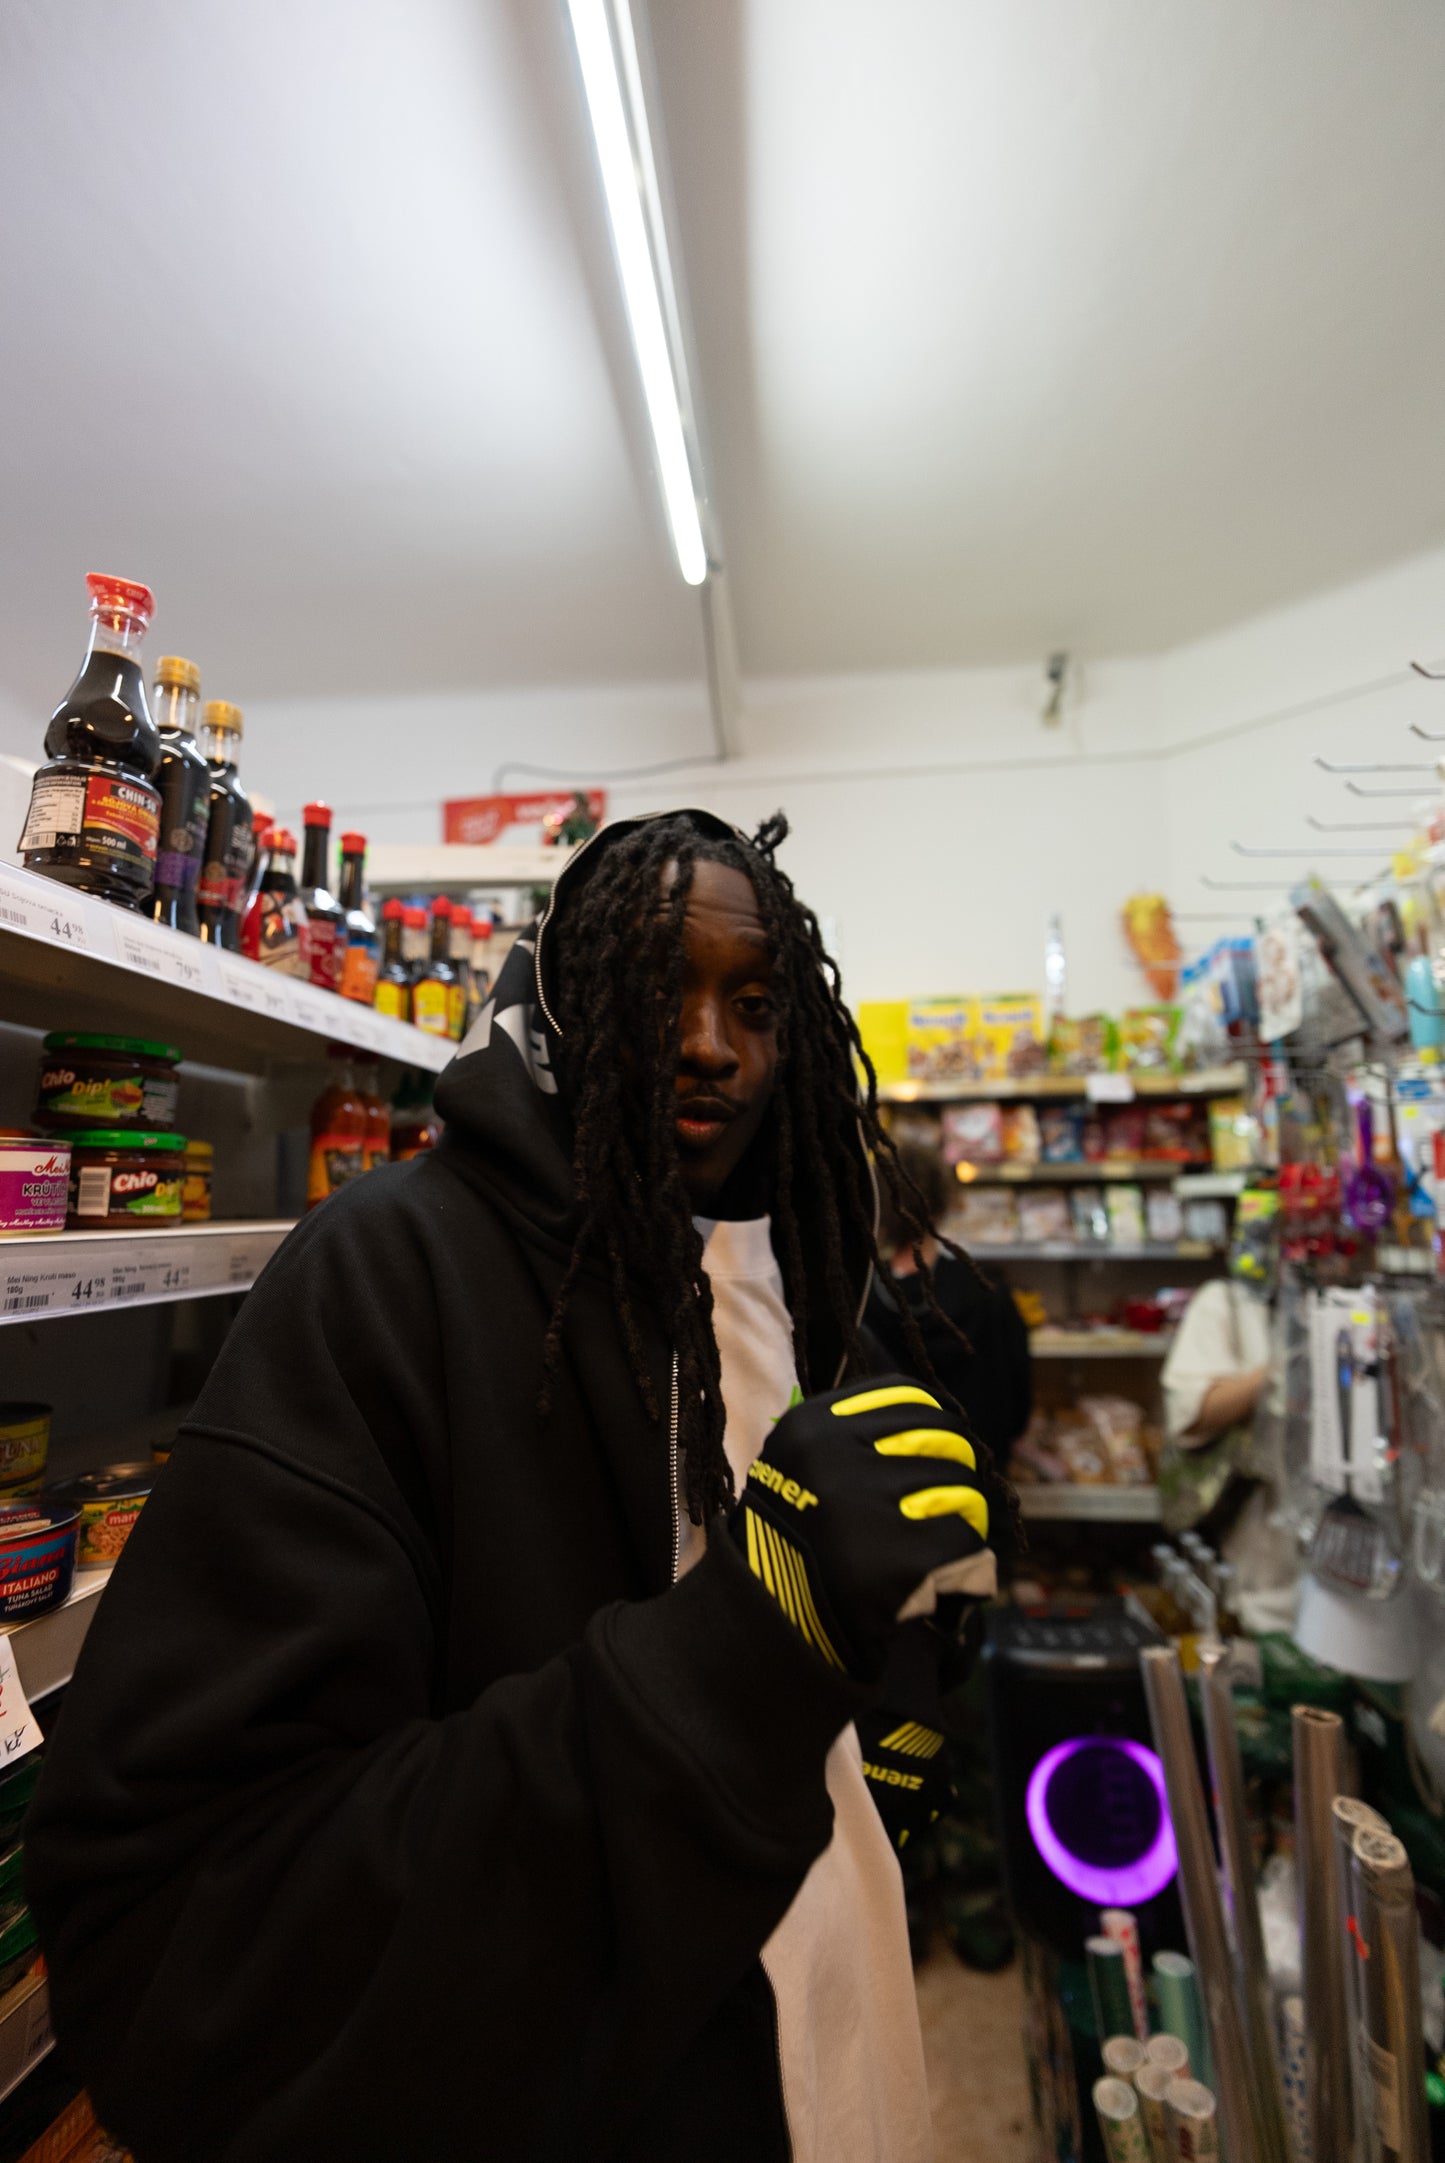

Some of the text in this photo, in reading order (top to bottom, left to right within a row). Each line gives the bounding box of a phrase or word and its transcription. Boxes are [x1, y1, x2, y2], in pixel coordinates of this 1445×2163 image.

[42, 1068, 76, 1089] Chio
[112, 1170, 158, 1193] Chio
[3, 1570, 57, 1596] ITALIANO
[863, 1761, 924, 1791] ziene
